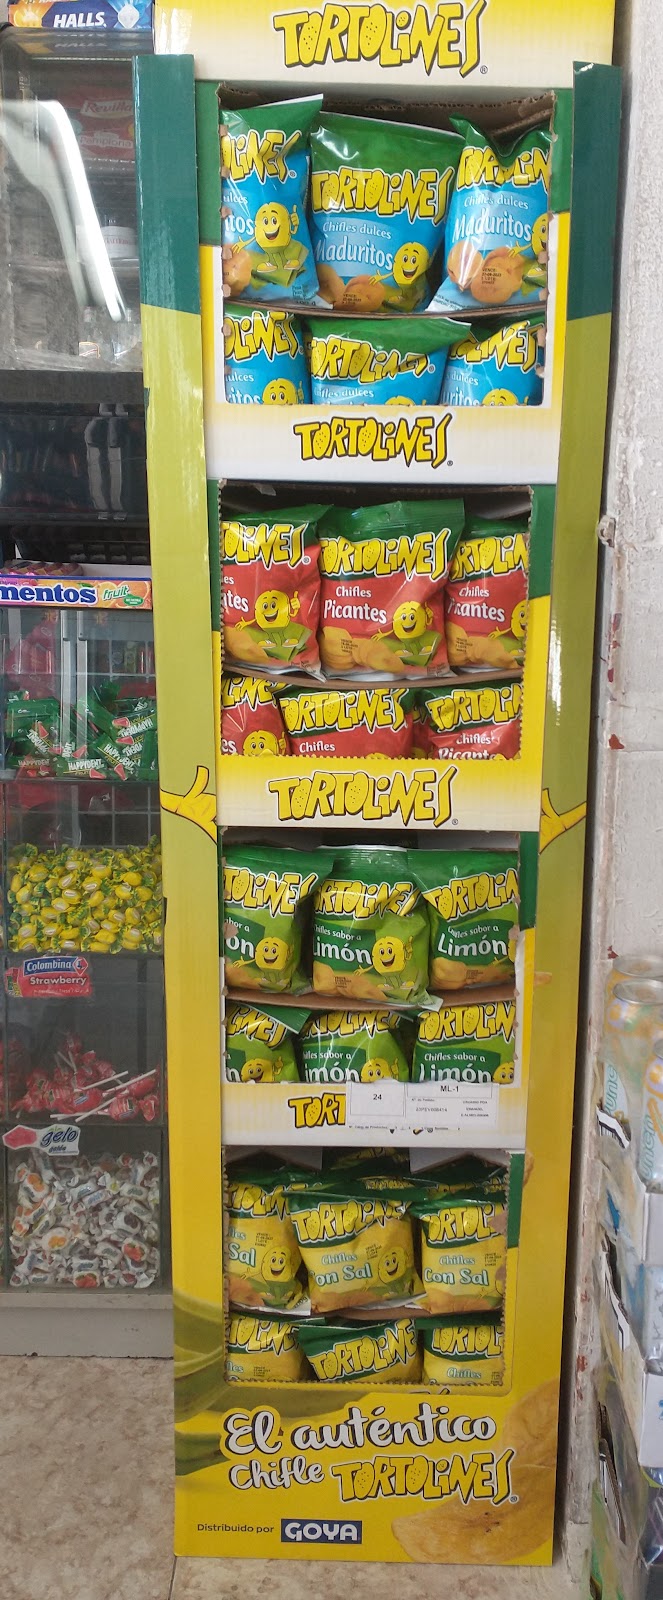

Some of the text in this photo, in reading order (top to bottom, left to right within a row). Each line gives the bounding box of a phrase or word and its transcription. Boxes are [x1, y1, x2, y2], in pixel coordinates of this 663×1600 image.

[53, 12, 105, 27] HALLS
[497, 194, 529, 210] dulces
[360, 223, 392, 239] dulces
[452, 208, 532, 243] Maduritos
[0, 584, 97, 604] mentos
[103, 585, 130, 601] fruit
[335, 586, 372, 598] Chifles
[459, 586, 490, 598] Chifles
[323, 599, 387, 624] Picantes
[299, 741, 336, 753] Chifles
[469, 925, 490, 936] sabor
[437, 933, 507, 957] Limón
[27, 959, 72, 970] Colombina
[30, 976, 87, 985] Strawberry
[424, 1052, 451, 1061] Chifles
[453, 1051, 478, 1061] sabor
[228, 1242, 256, 1267] Sal
[321, 1252, 357, 1265] Chifles
[440, 1255, 475, 1265] Chifles
[343, 1262, 373, 1281] Sal
[424, 1268, 489, 1286] Con Sal
[447, 1367, 482, 1379] Chifles
[224, 1402, 496, 1455] El auténtico
[229, 1455, 325, 1490] Chifle
[197, 1522, 358, 1542] Distribuido por GOYA
